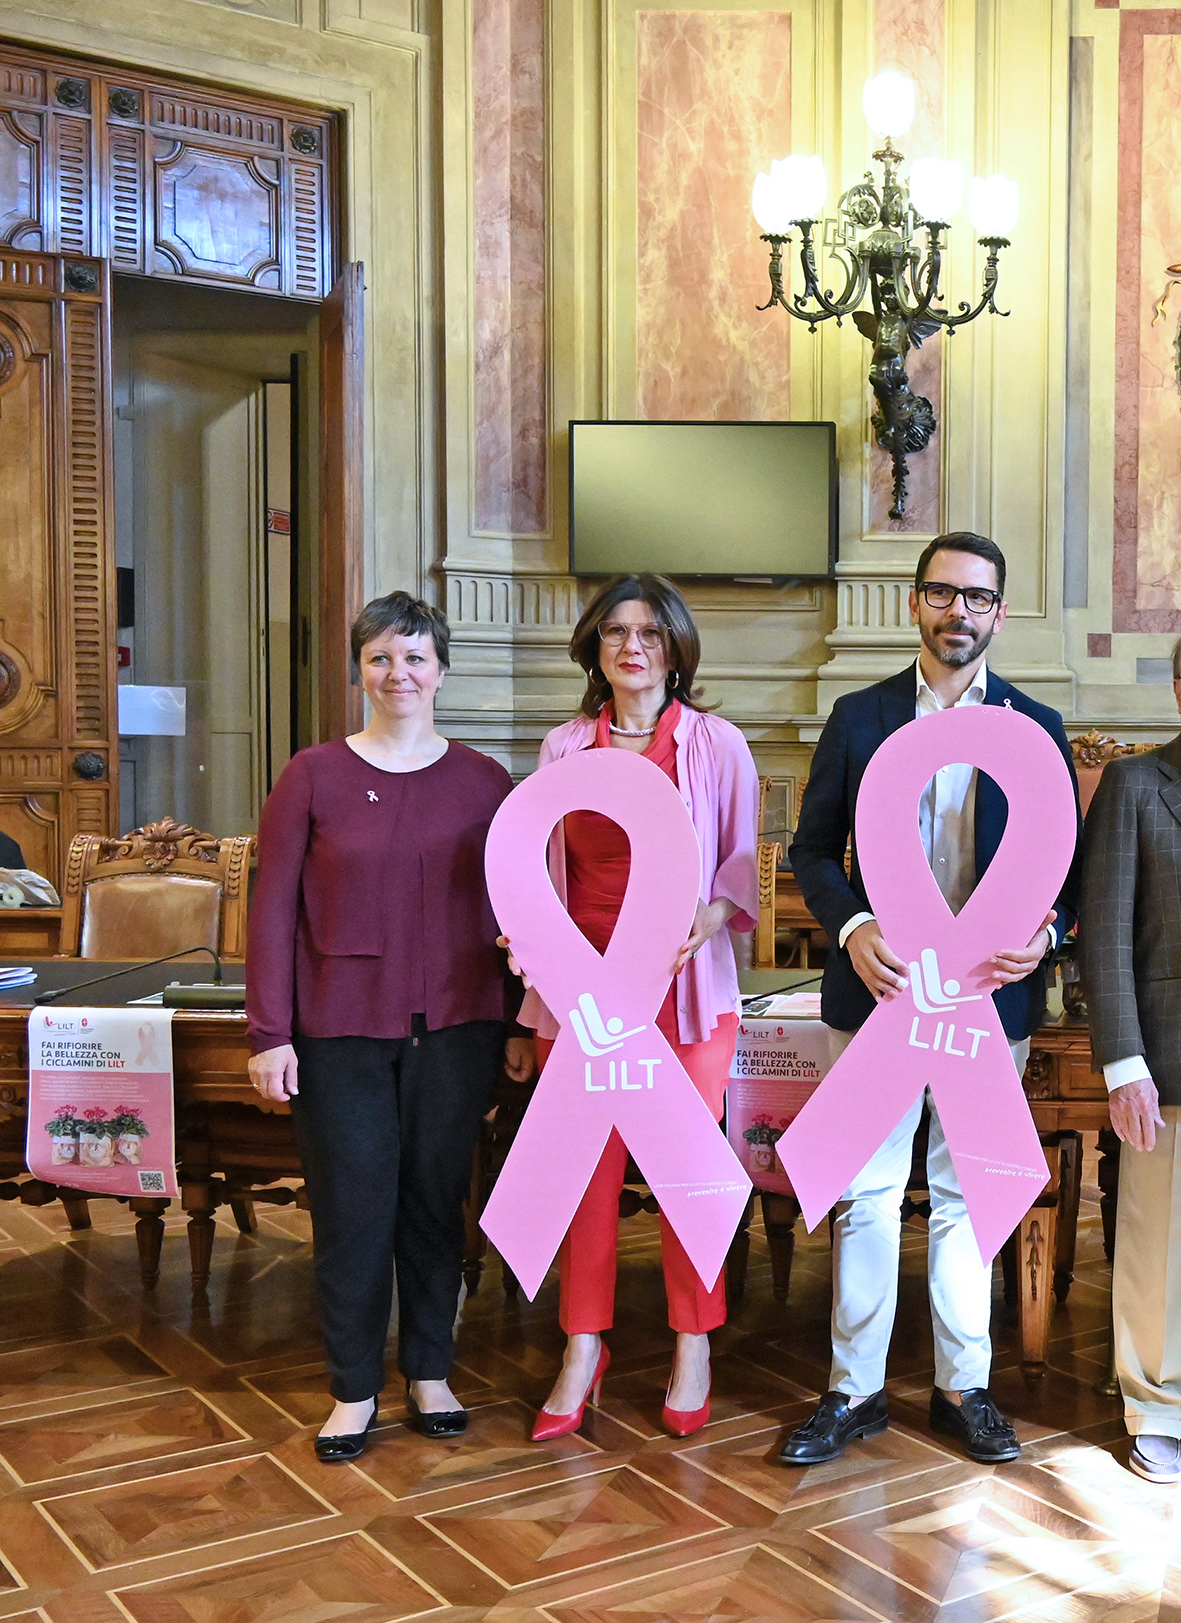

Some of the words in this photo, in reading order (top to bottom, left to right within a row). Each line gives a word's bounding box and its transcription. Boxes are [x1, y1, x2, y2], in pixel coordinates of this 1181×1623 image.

[909, 1016, 990, 1058] LILT
[58, 1042, 102, 1050] RIFIORIRE
[754, 1051, 797, 1059] RIFIORIRE
[46, 1059, 94, 1067] CICLAMINI
[751, 1059, 793, 1067] BELLEZZA
[585, 1059, 662, 1091] LILT
[742, 1068, 789, 1076] CICLAMINI
[985, 1168, 1016, 1176] prevenire
[687, 1188, 718, 1197] prevenire
